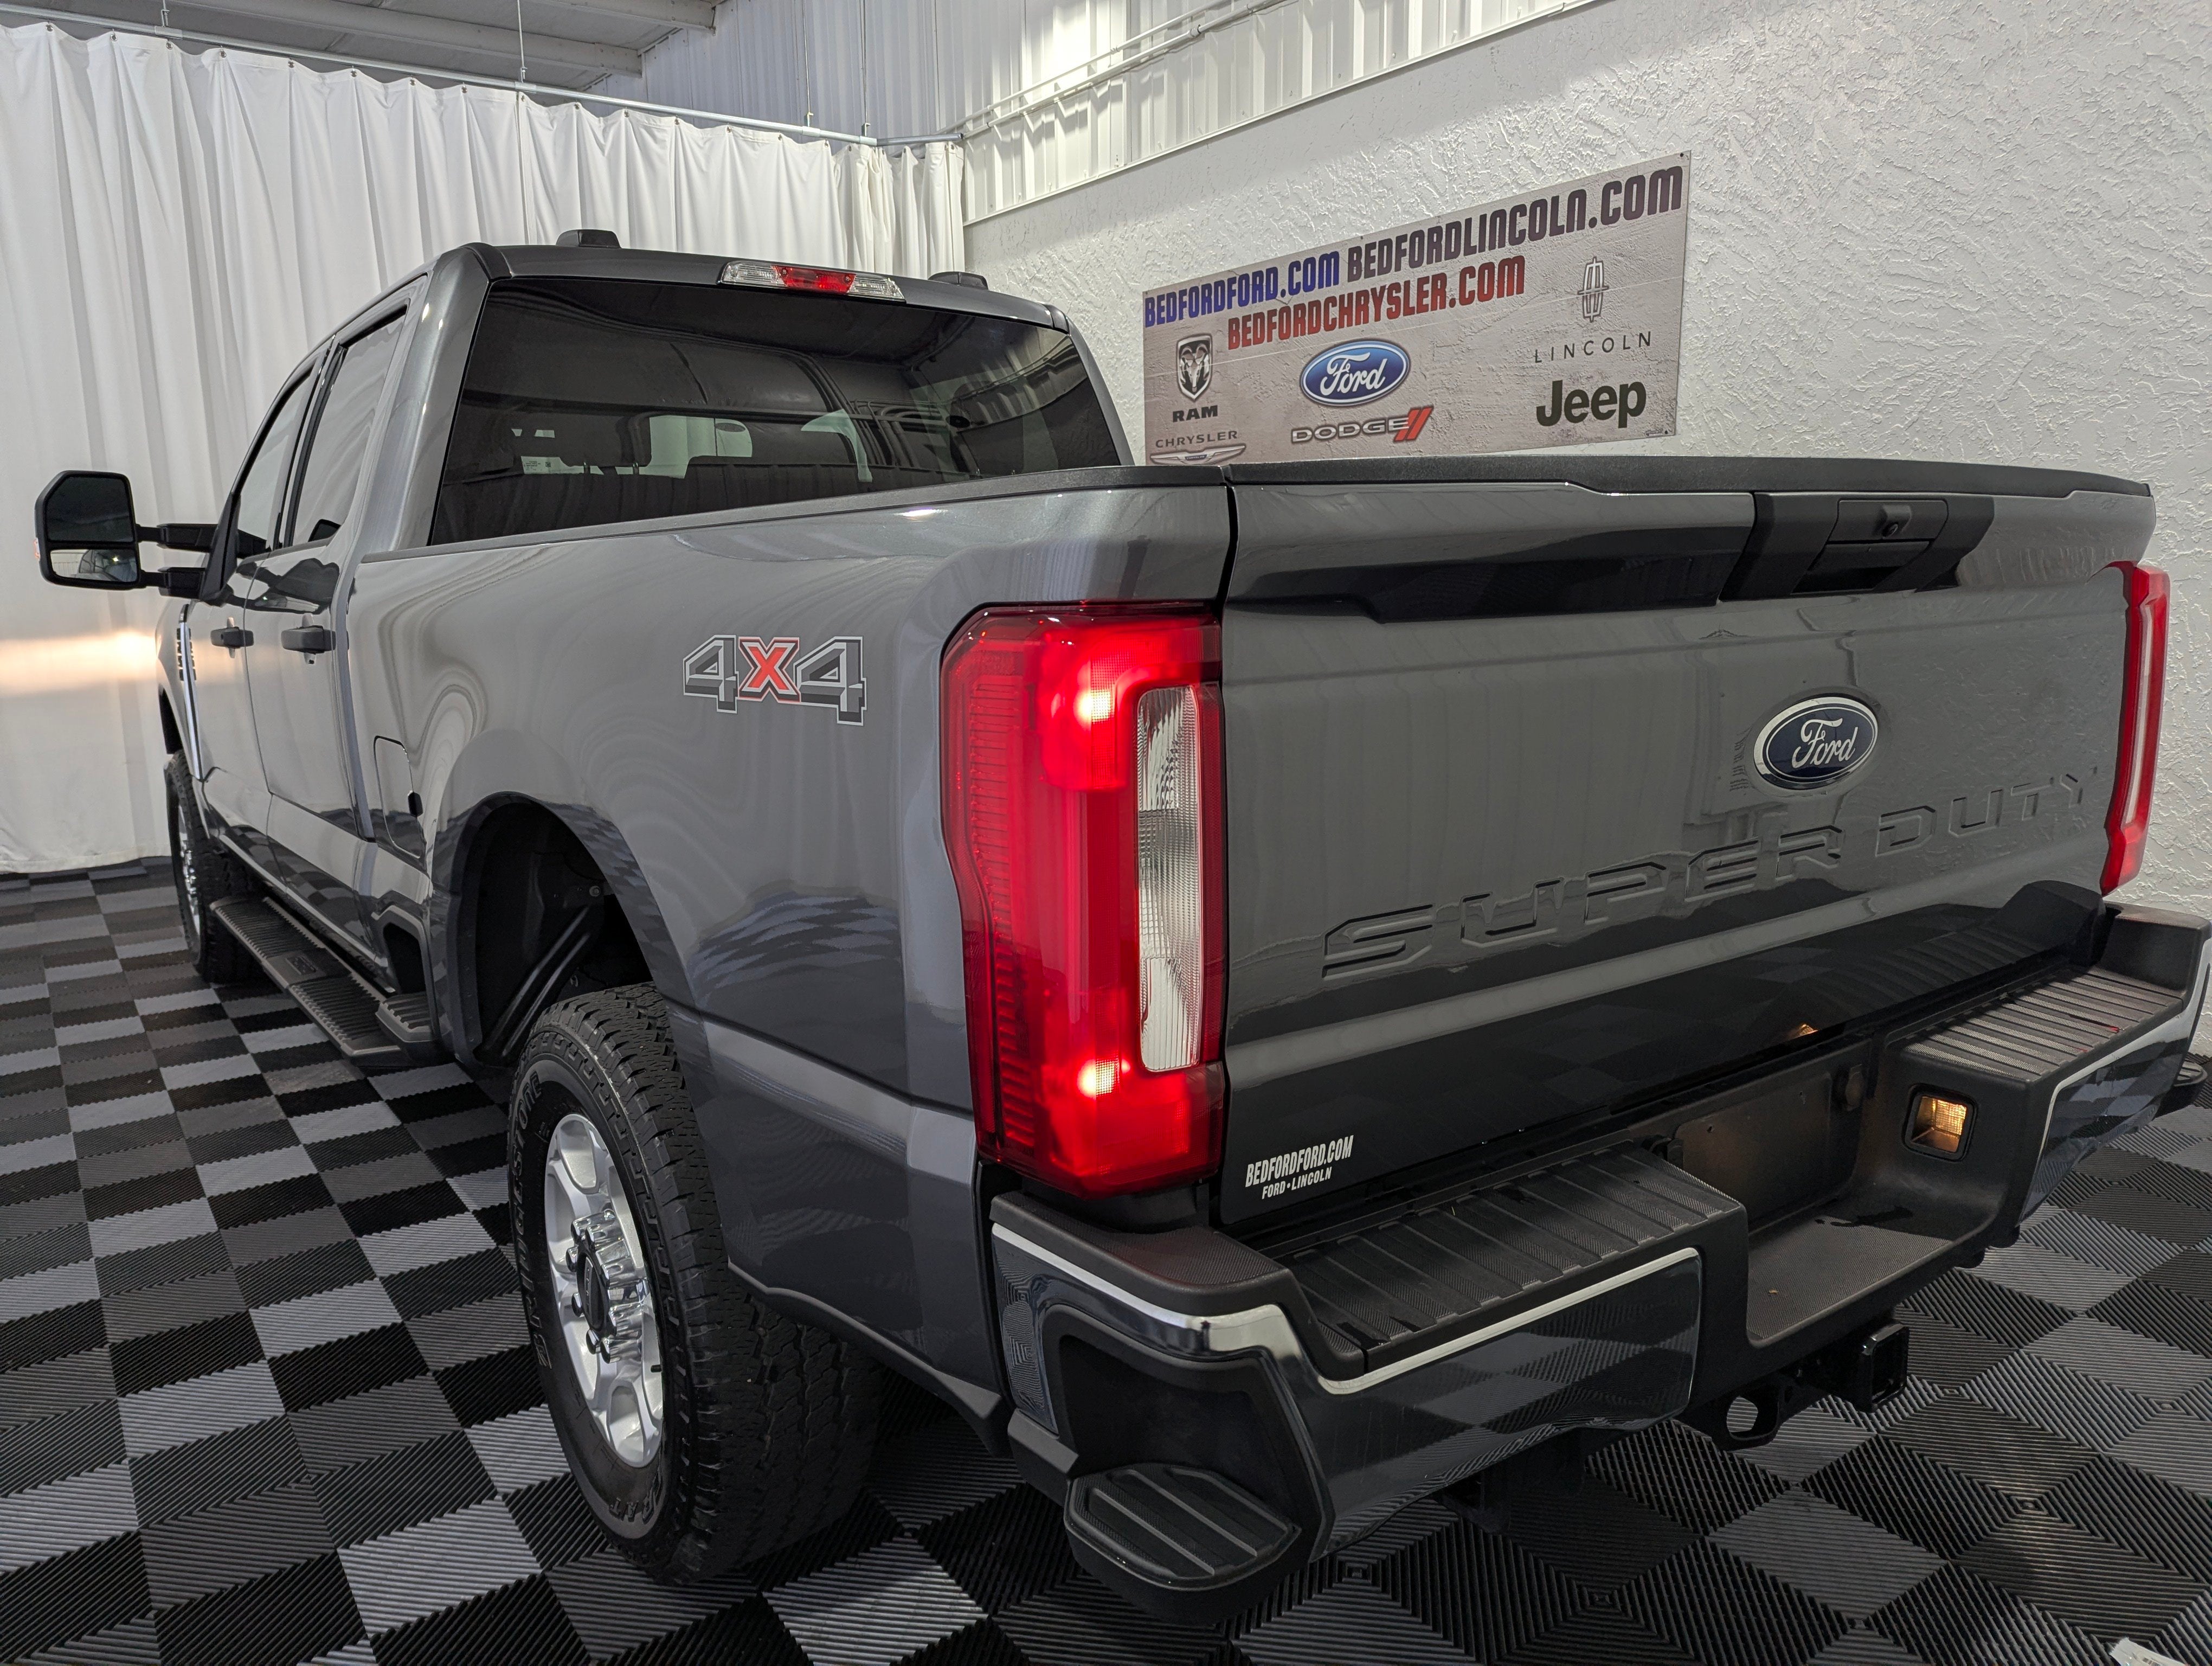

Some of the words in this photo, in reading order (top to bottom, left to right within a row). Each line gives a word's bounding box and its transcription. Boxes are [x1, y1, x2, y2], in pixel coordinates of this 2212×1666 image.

[1145, 251, 1340, 328] BEDFORDFORD.COM
[1347, 165, 1683, 283] BEDFORDLINCOLN.COM
[1228, 254, 1525, 350] BEDFORDCHRYSLER.COM
[1535, 331, 1651, 363] LINCOLN
[1320, 352, 1388, 396] Ford
[1173, 405, 1218, 422] RAM
[1536, 380, 1647, 428] Jeep
[1155, 431, 1237, 448] CHRYSLER
[1290, 415, 1410, 444] DODGE
[1791, 717, 1859, 768] Ford
[1321, 824, 1843, 981] SUPER
[1875, 766, 2098, 857] DUTY
[1245, 1135, 1354, 1188] BEDFORDFORD.COM
